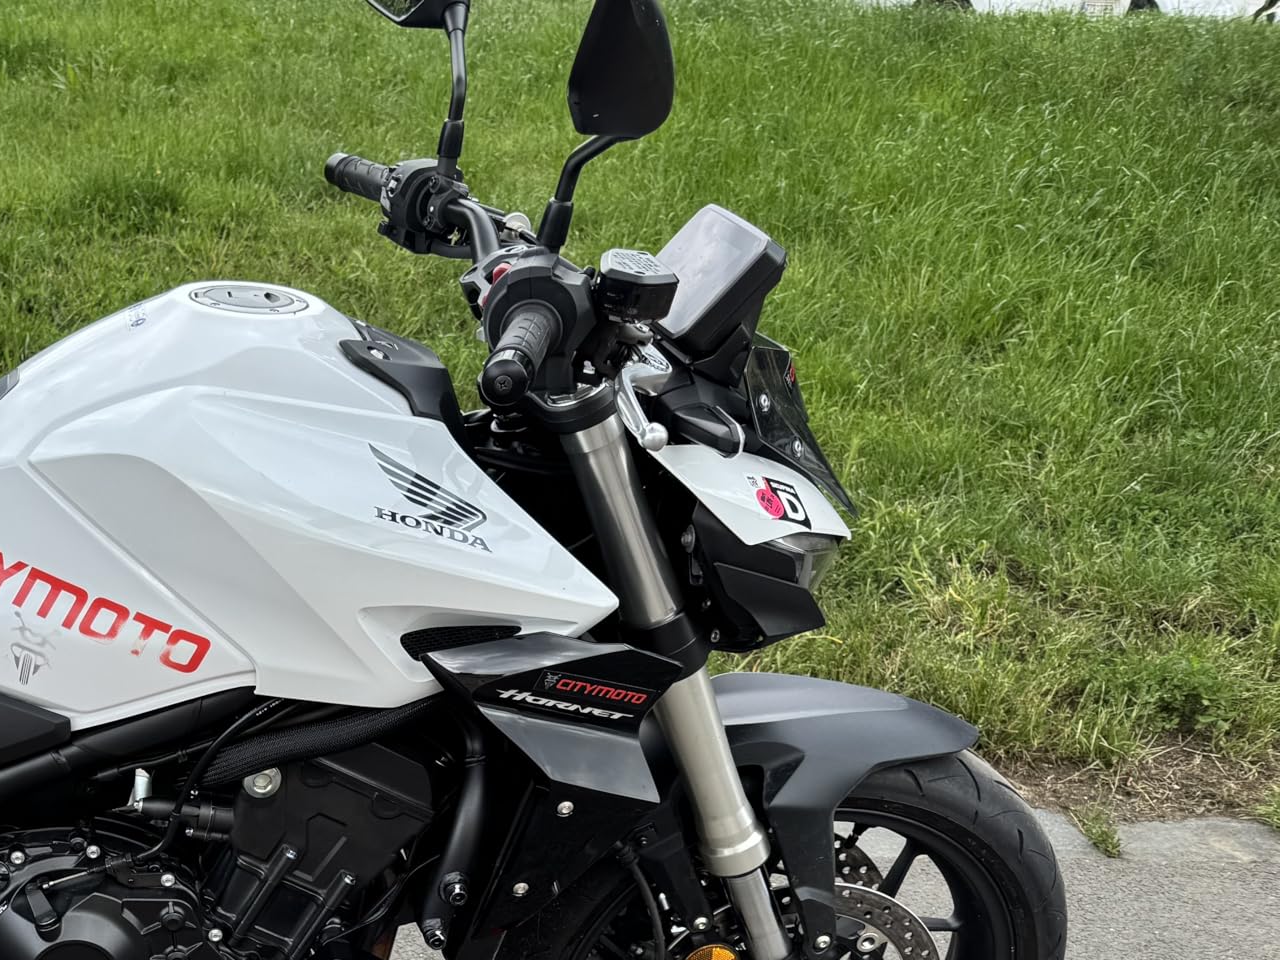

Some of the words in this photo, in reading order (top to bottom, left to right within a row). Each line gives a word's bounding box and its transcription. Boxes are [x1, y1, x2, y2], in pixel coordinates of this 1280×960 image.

[373, 505, 493, 554] HONDA
[496, 688, 635, 720] HORNET
[556, 678, 648, 705] CITYMOTO
